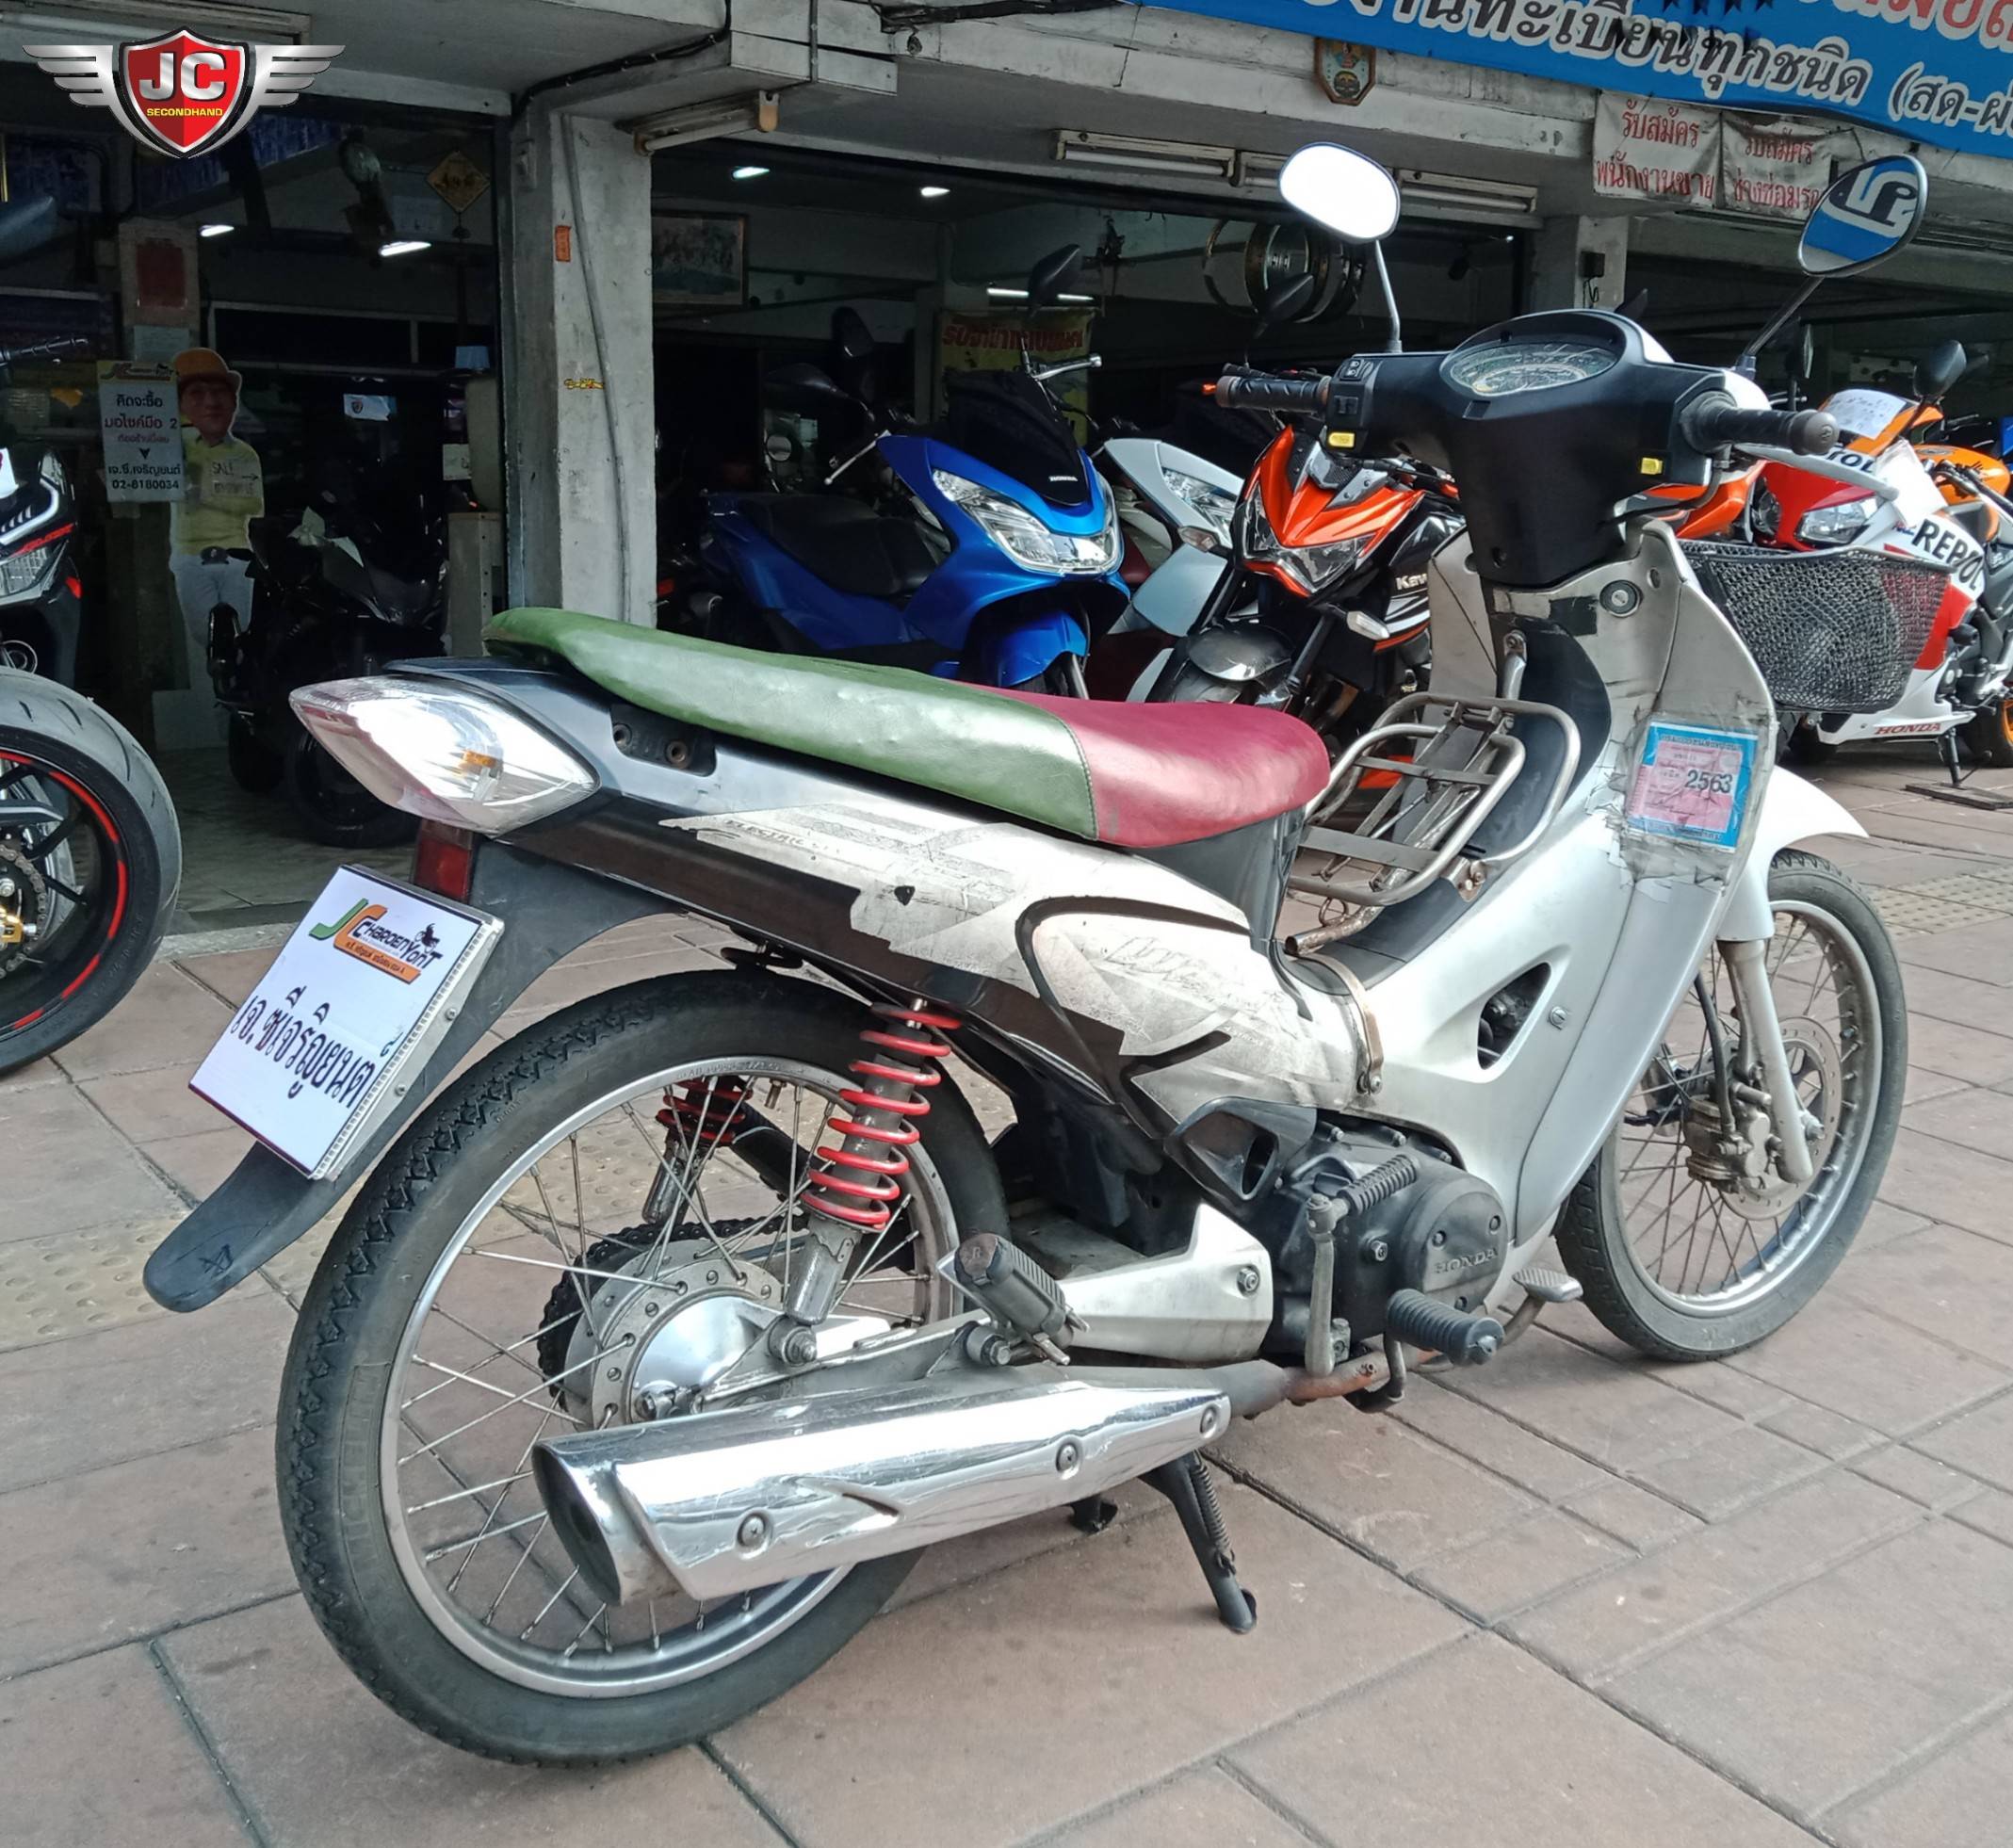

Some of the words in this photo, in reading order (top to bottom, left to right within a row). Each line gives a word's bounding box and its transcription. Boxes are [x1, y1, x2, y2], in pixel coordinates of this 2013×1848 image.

[1622, 99, 1700, 148] รับสมัคร
[1596, 150, 1716, 201] พนักงานขาย
[170, 417, 178, 430] 2
[1874, 722, 1942, 736] HONDA
[1684, 770, 1734, 794] 2563
